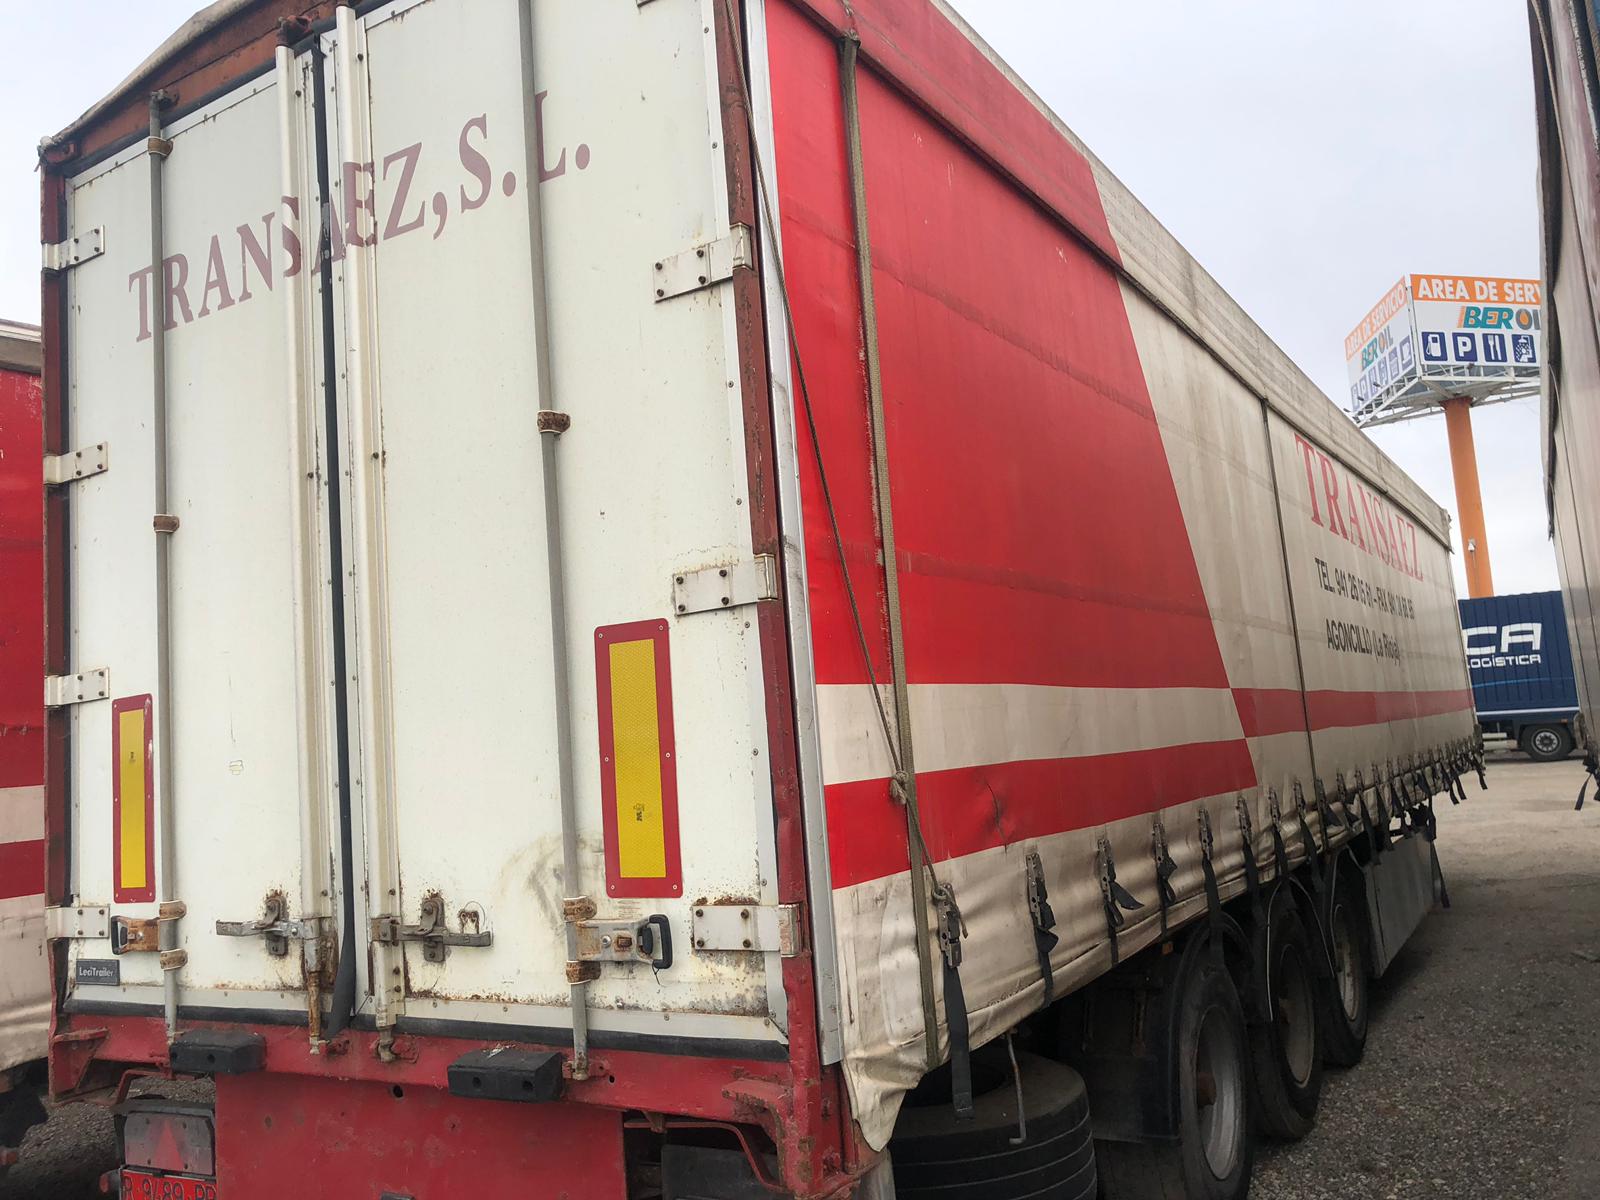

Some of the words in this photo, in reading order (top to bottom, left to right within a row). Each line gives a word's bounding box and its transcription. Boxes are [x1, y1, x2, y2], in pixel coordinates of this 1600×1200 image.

[1418, 278, 1470, 300] AREA
[1474, 280, 1500, 302] DE
[1294, 432, 1423, 582] TRANSAEZ
[1326, 618, 1372, 655] AGONCILLO
[79, 966, 114, 977] LeciTrailer
